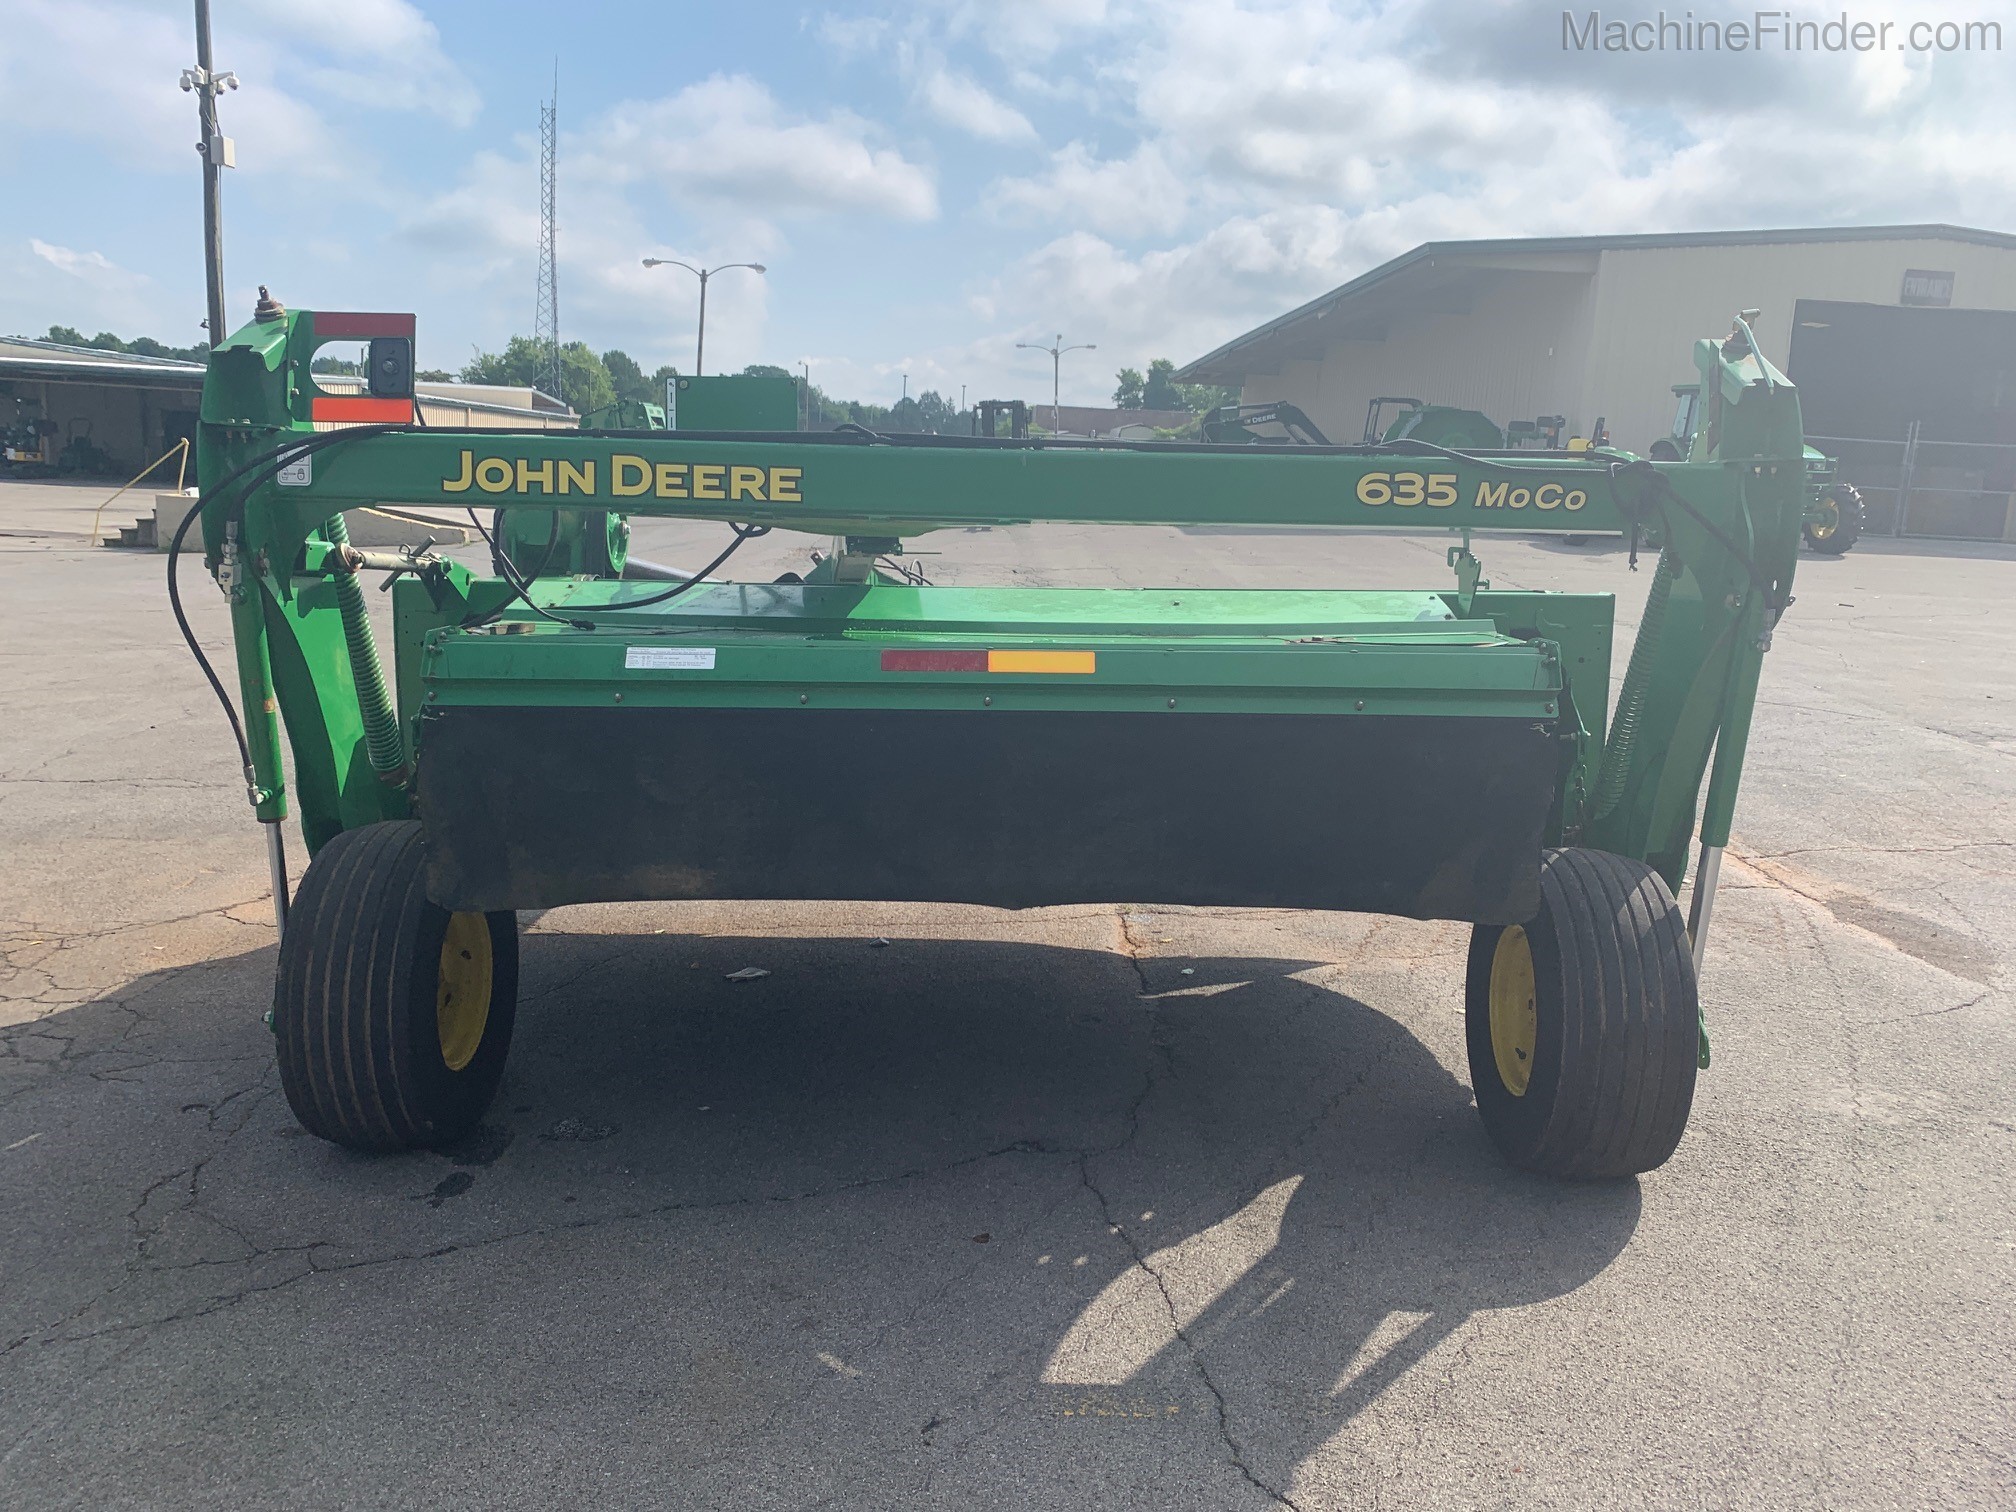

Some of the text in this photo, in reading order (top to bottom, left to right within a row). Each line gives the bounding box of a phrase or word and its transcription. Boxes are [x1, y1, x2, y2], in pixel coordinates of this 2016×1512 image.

[442, 450, 802, 502] JOHN DEERE
[1356, 472, 1587, 510] 635 MoCo
